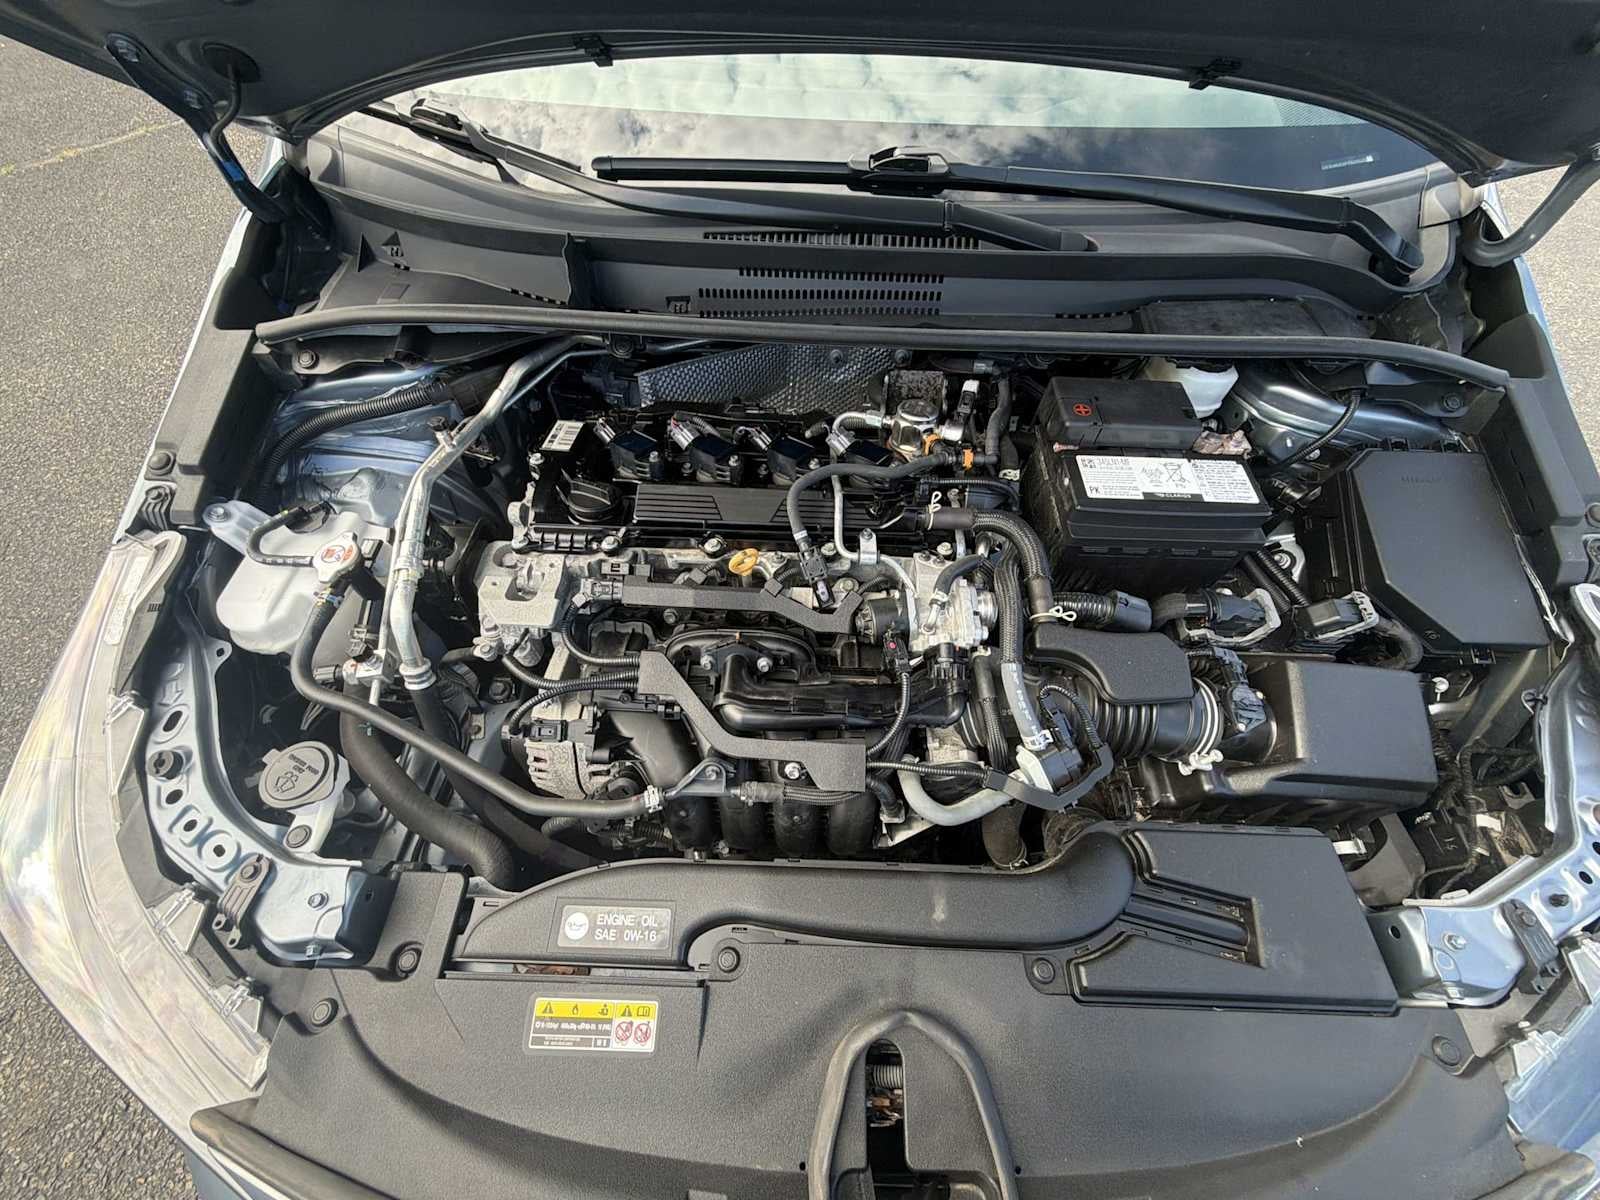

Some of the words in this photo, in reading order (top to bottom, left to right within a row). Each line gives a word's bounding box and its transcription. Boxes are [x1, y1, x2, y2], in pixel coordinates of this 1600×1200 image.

[1089, 486, 1100, 494] PK
[596, 913, 636, 926] ENGINE
[641, 915, 658, 927] OIL
[594, 928, 617, 941] SAE
[623, 930, 657, 942] 0W-16
